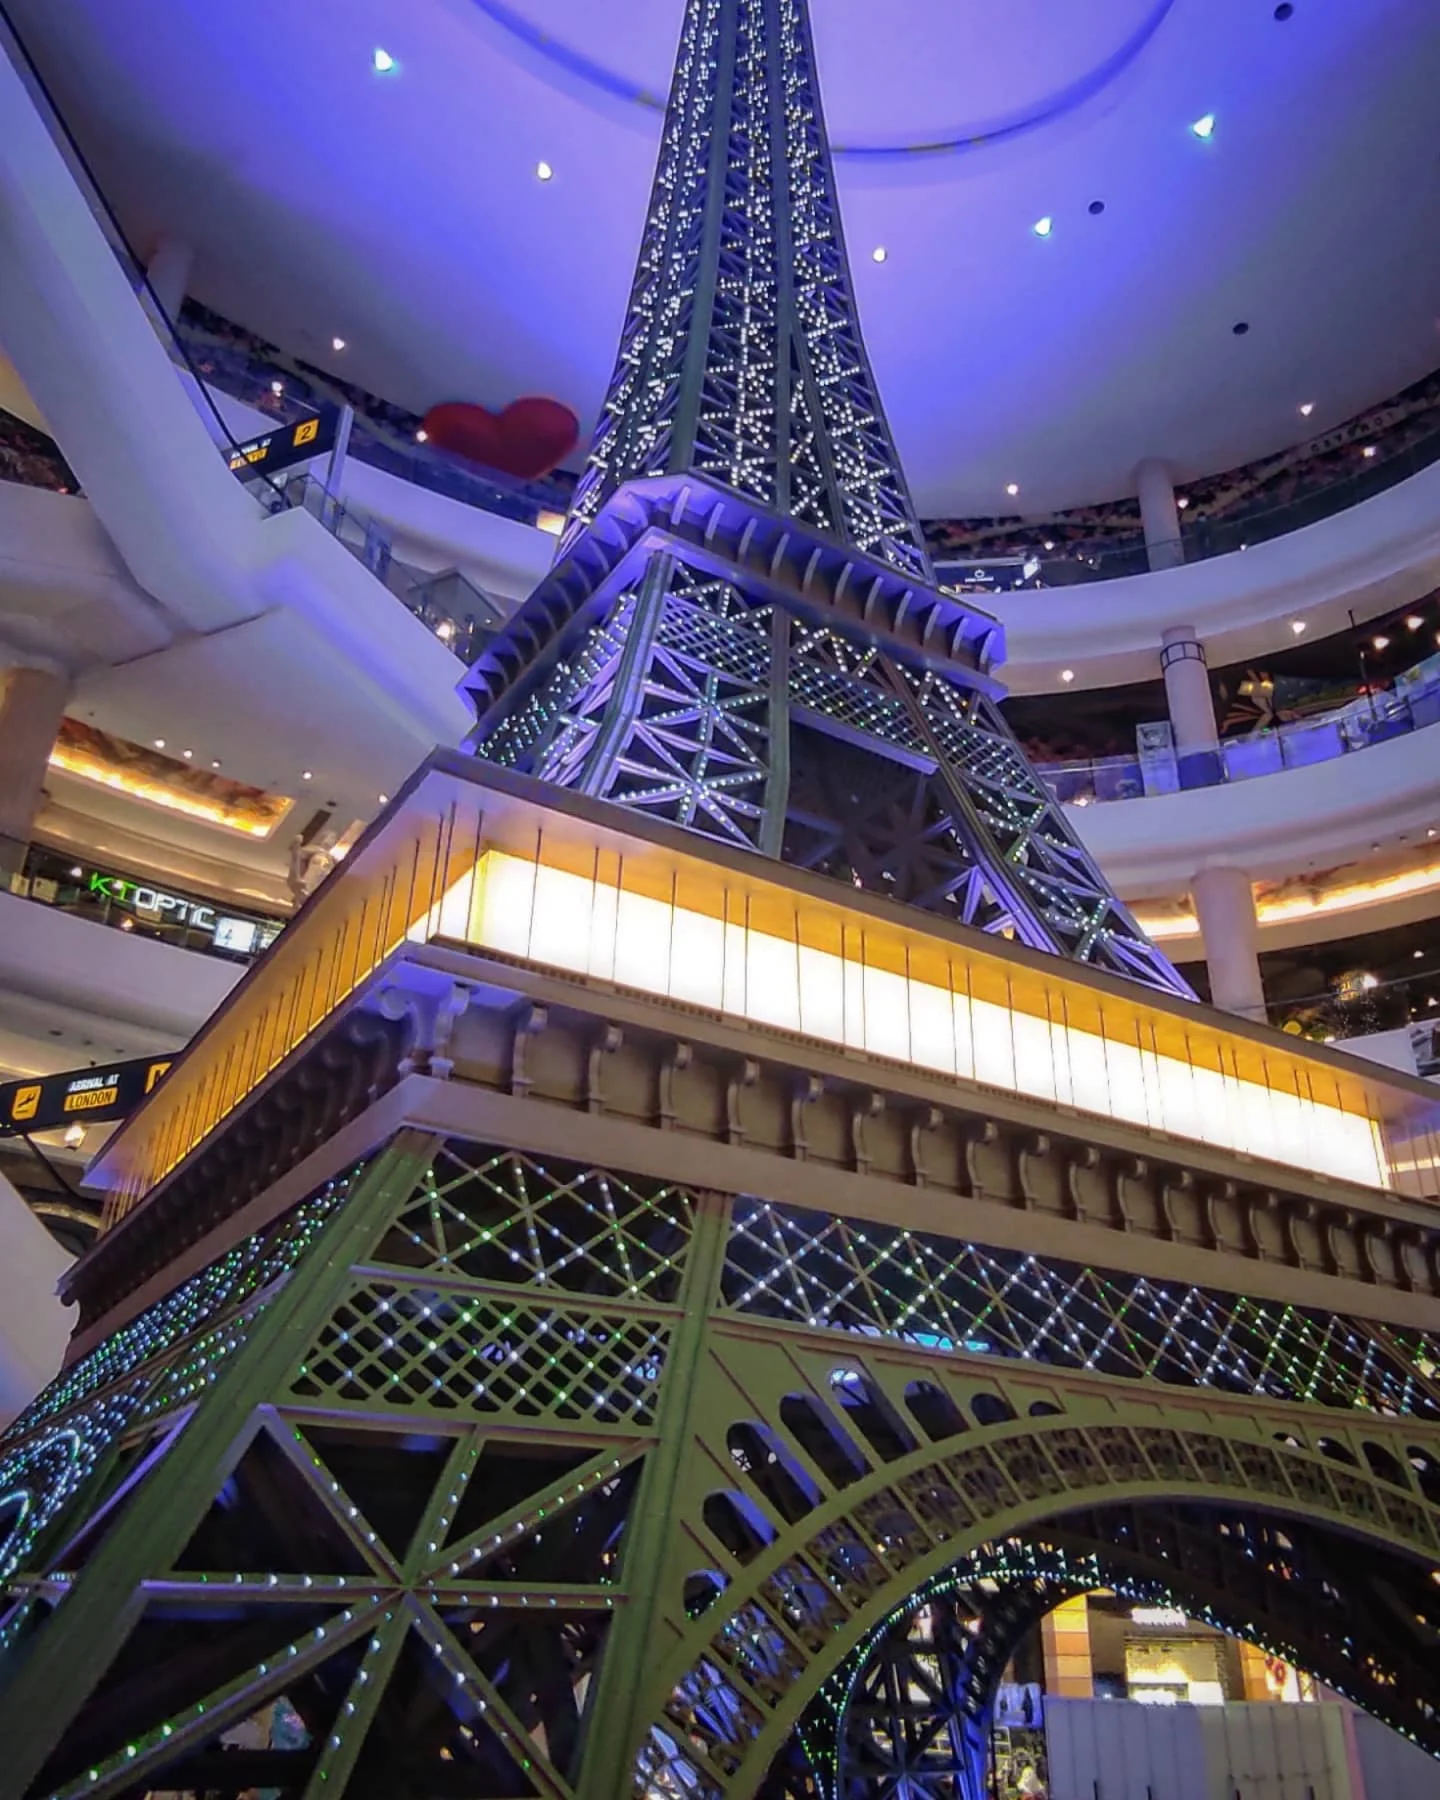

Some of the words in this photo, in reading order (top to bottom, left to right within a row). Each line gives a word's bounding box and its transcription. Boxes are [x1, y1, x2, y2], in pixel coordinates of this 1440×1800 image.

[301, 425, 312, 440] 2
[107, 1073, 120, 1086] AT
[69, 1090, 112, 1109] LONDON
